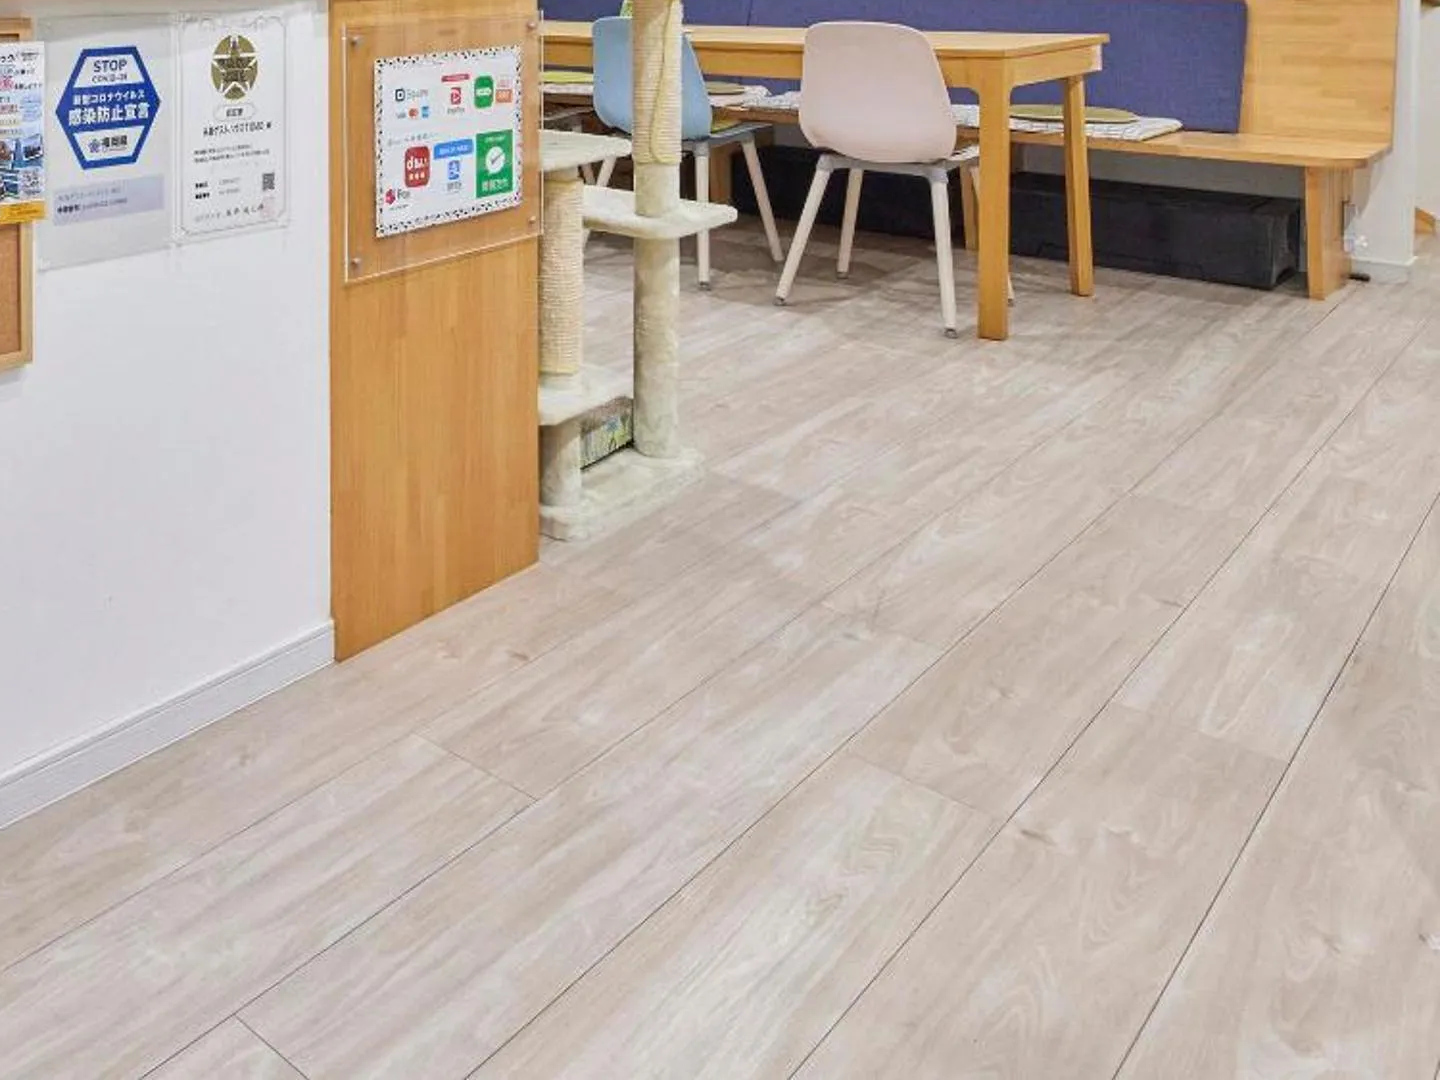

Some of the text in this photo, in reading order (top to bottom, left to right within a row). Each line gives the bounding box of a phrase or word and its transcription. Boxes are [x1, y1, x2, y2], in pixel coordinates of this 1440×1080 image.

[93, 60, 128, 73] STOP
[68, 102, 150, 126] 感染防止宣言
